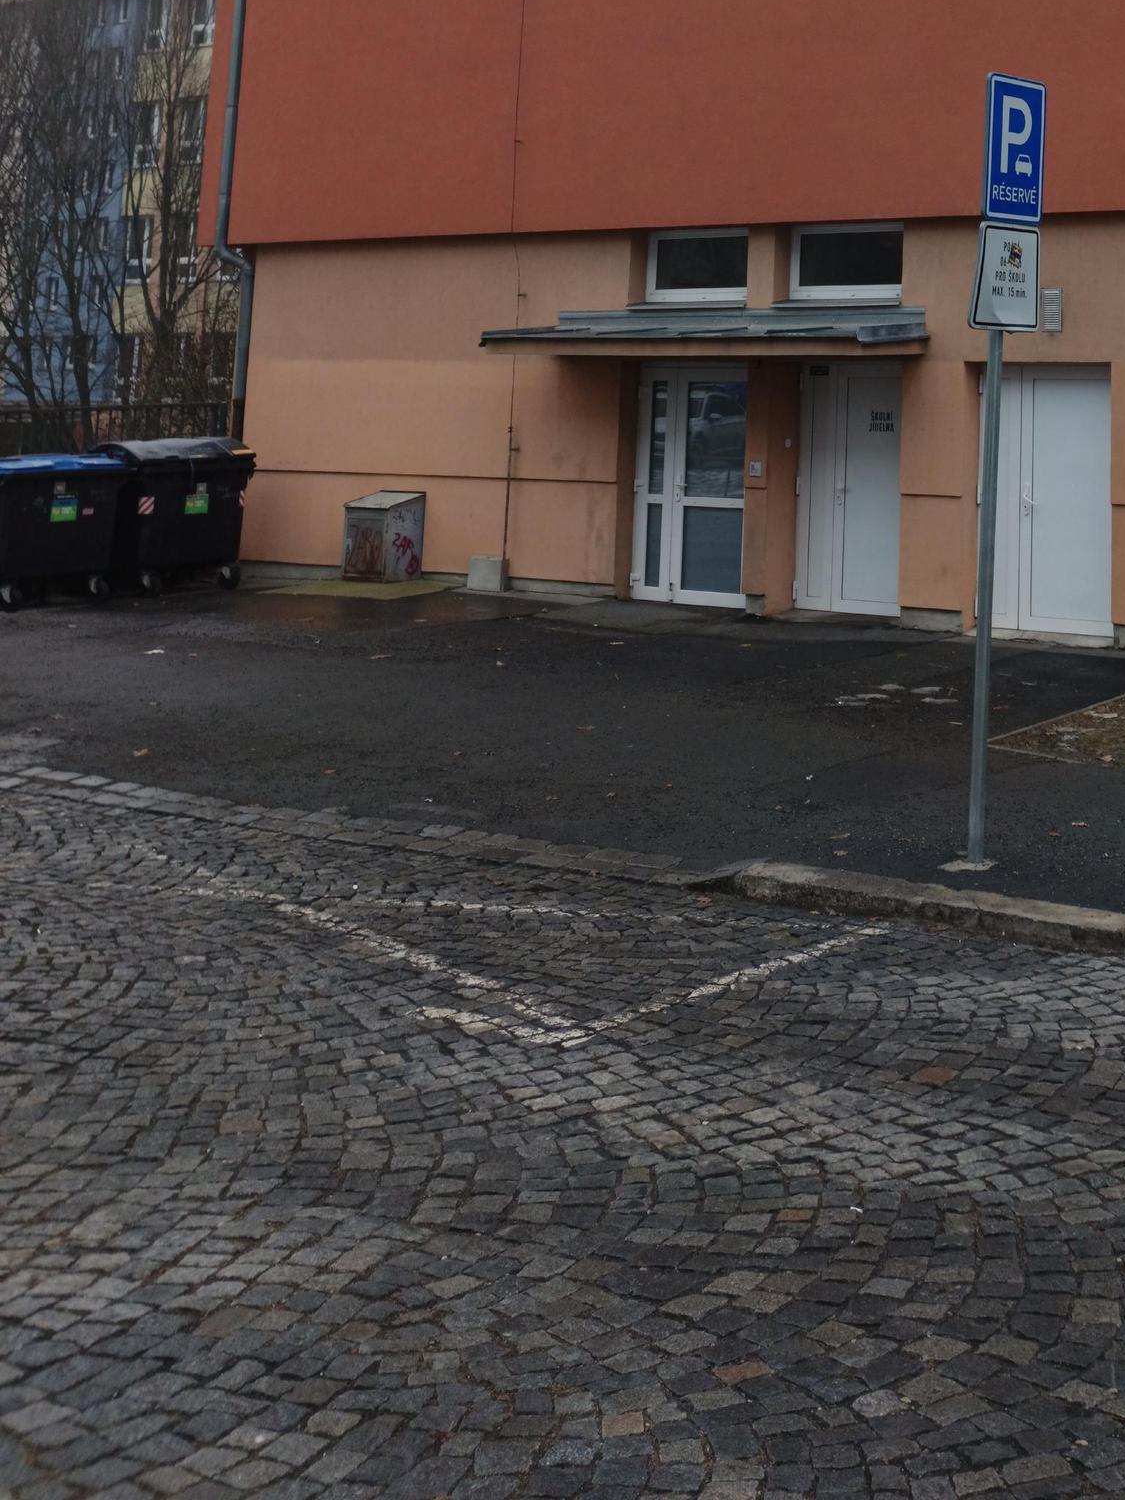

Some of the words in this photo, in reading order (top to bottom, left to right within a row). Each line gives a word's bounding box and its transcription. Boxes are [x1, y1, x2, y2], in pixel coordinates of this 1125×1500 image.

[1000, 95, 1033, 174] P
[992, 182, 1037, 205] RÉSERVÉ
[995, 270, 1006, 281] PRO
[1008, 269, 1026, 283] ŠKOLU
[991, 285, 1005, 297] MAX.
[1008, 286, 1014, 297] 15
[870, 409, 894, 421] ŠKOLNÍ
[868, 421, 895, 432] JÍDELNA
